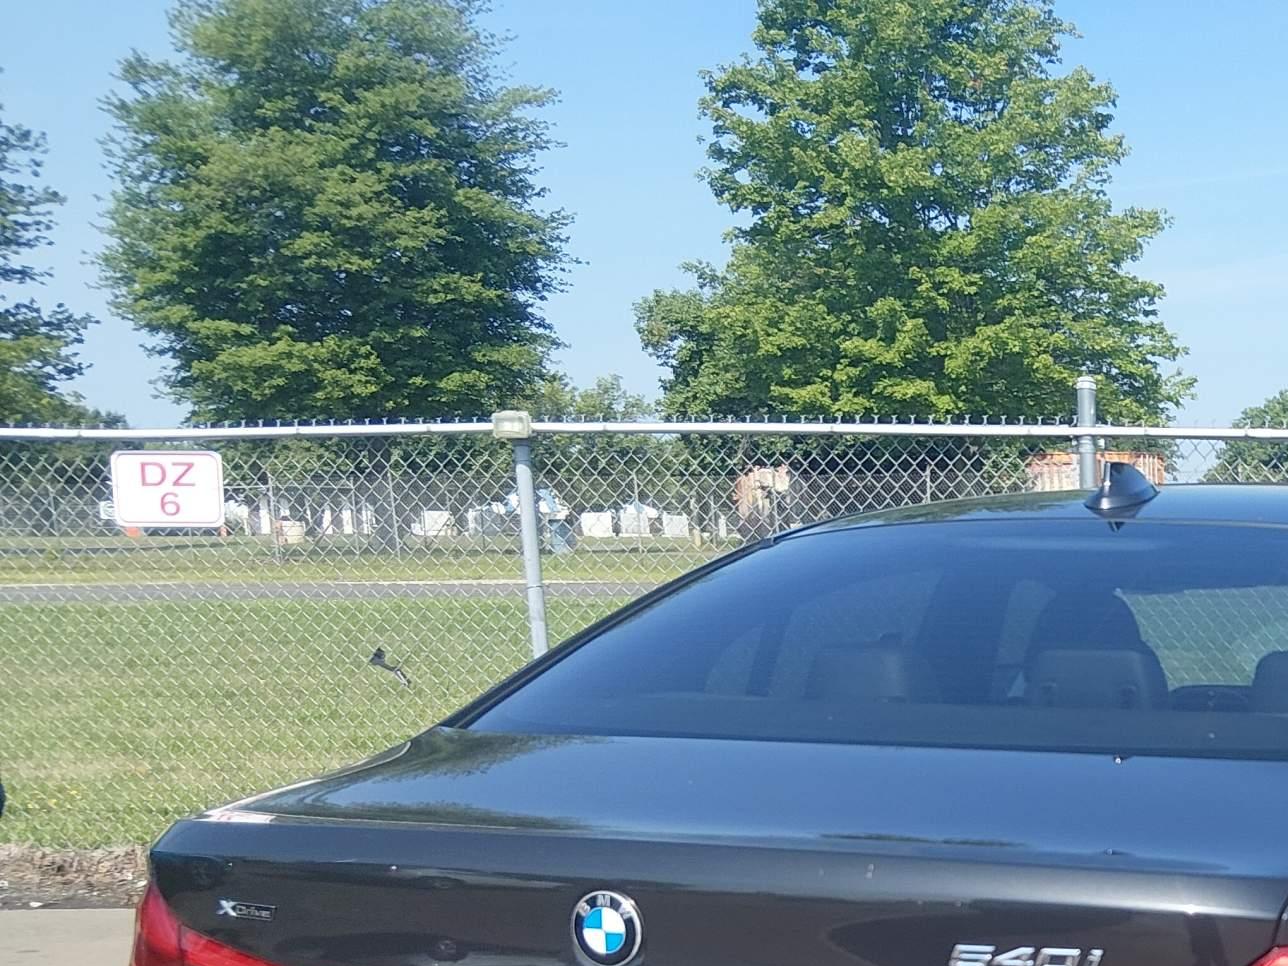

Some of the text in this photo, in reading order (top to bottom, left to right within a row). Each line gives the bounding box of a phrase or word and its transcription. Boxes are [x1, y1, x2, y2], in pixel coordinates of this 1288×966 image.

[140, 462, 196, 487] DZ
[160, 492, 180, 516] 6
[578, 894, 633, 919] BMW
